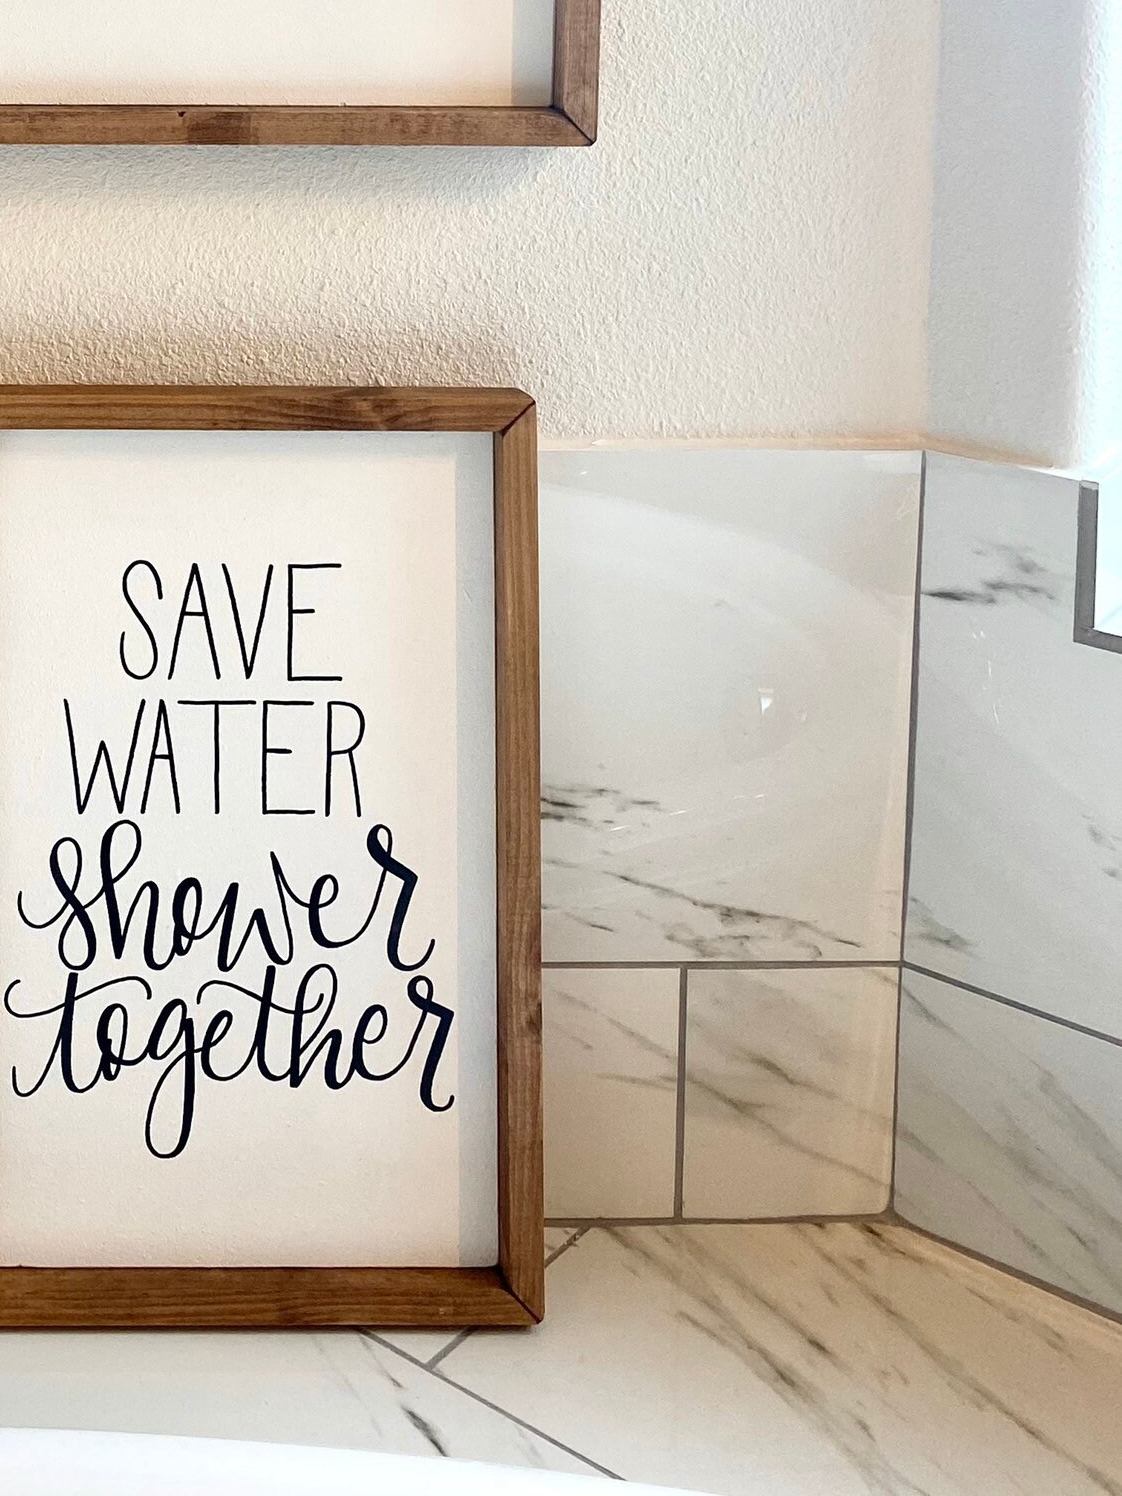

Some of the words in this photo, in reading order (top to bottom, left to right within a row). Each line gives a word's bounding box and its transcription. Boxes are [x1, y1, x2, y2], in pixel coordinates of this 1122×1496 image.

[119, 559, 344, 682] SAVE
[63, 698, 366, 818] WATER
[17, 819, 436, 973] shower
[3, 963, 455, 1159] together
